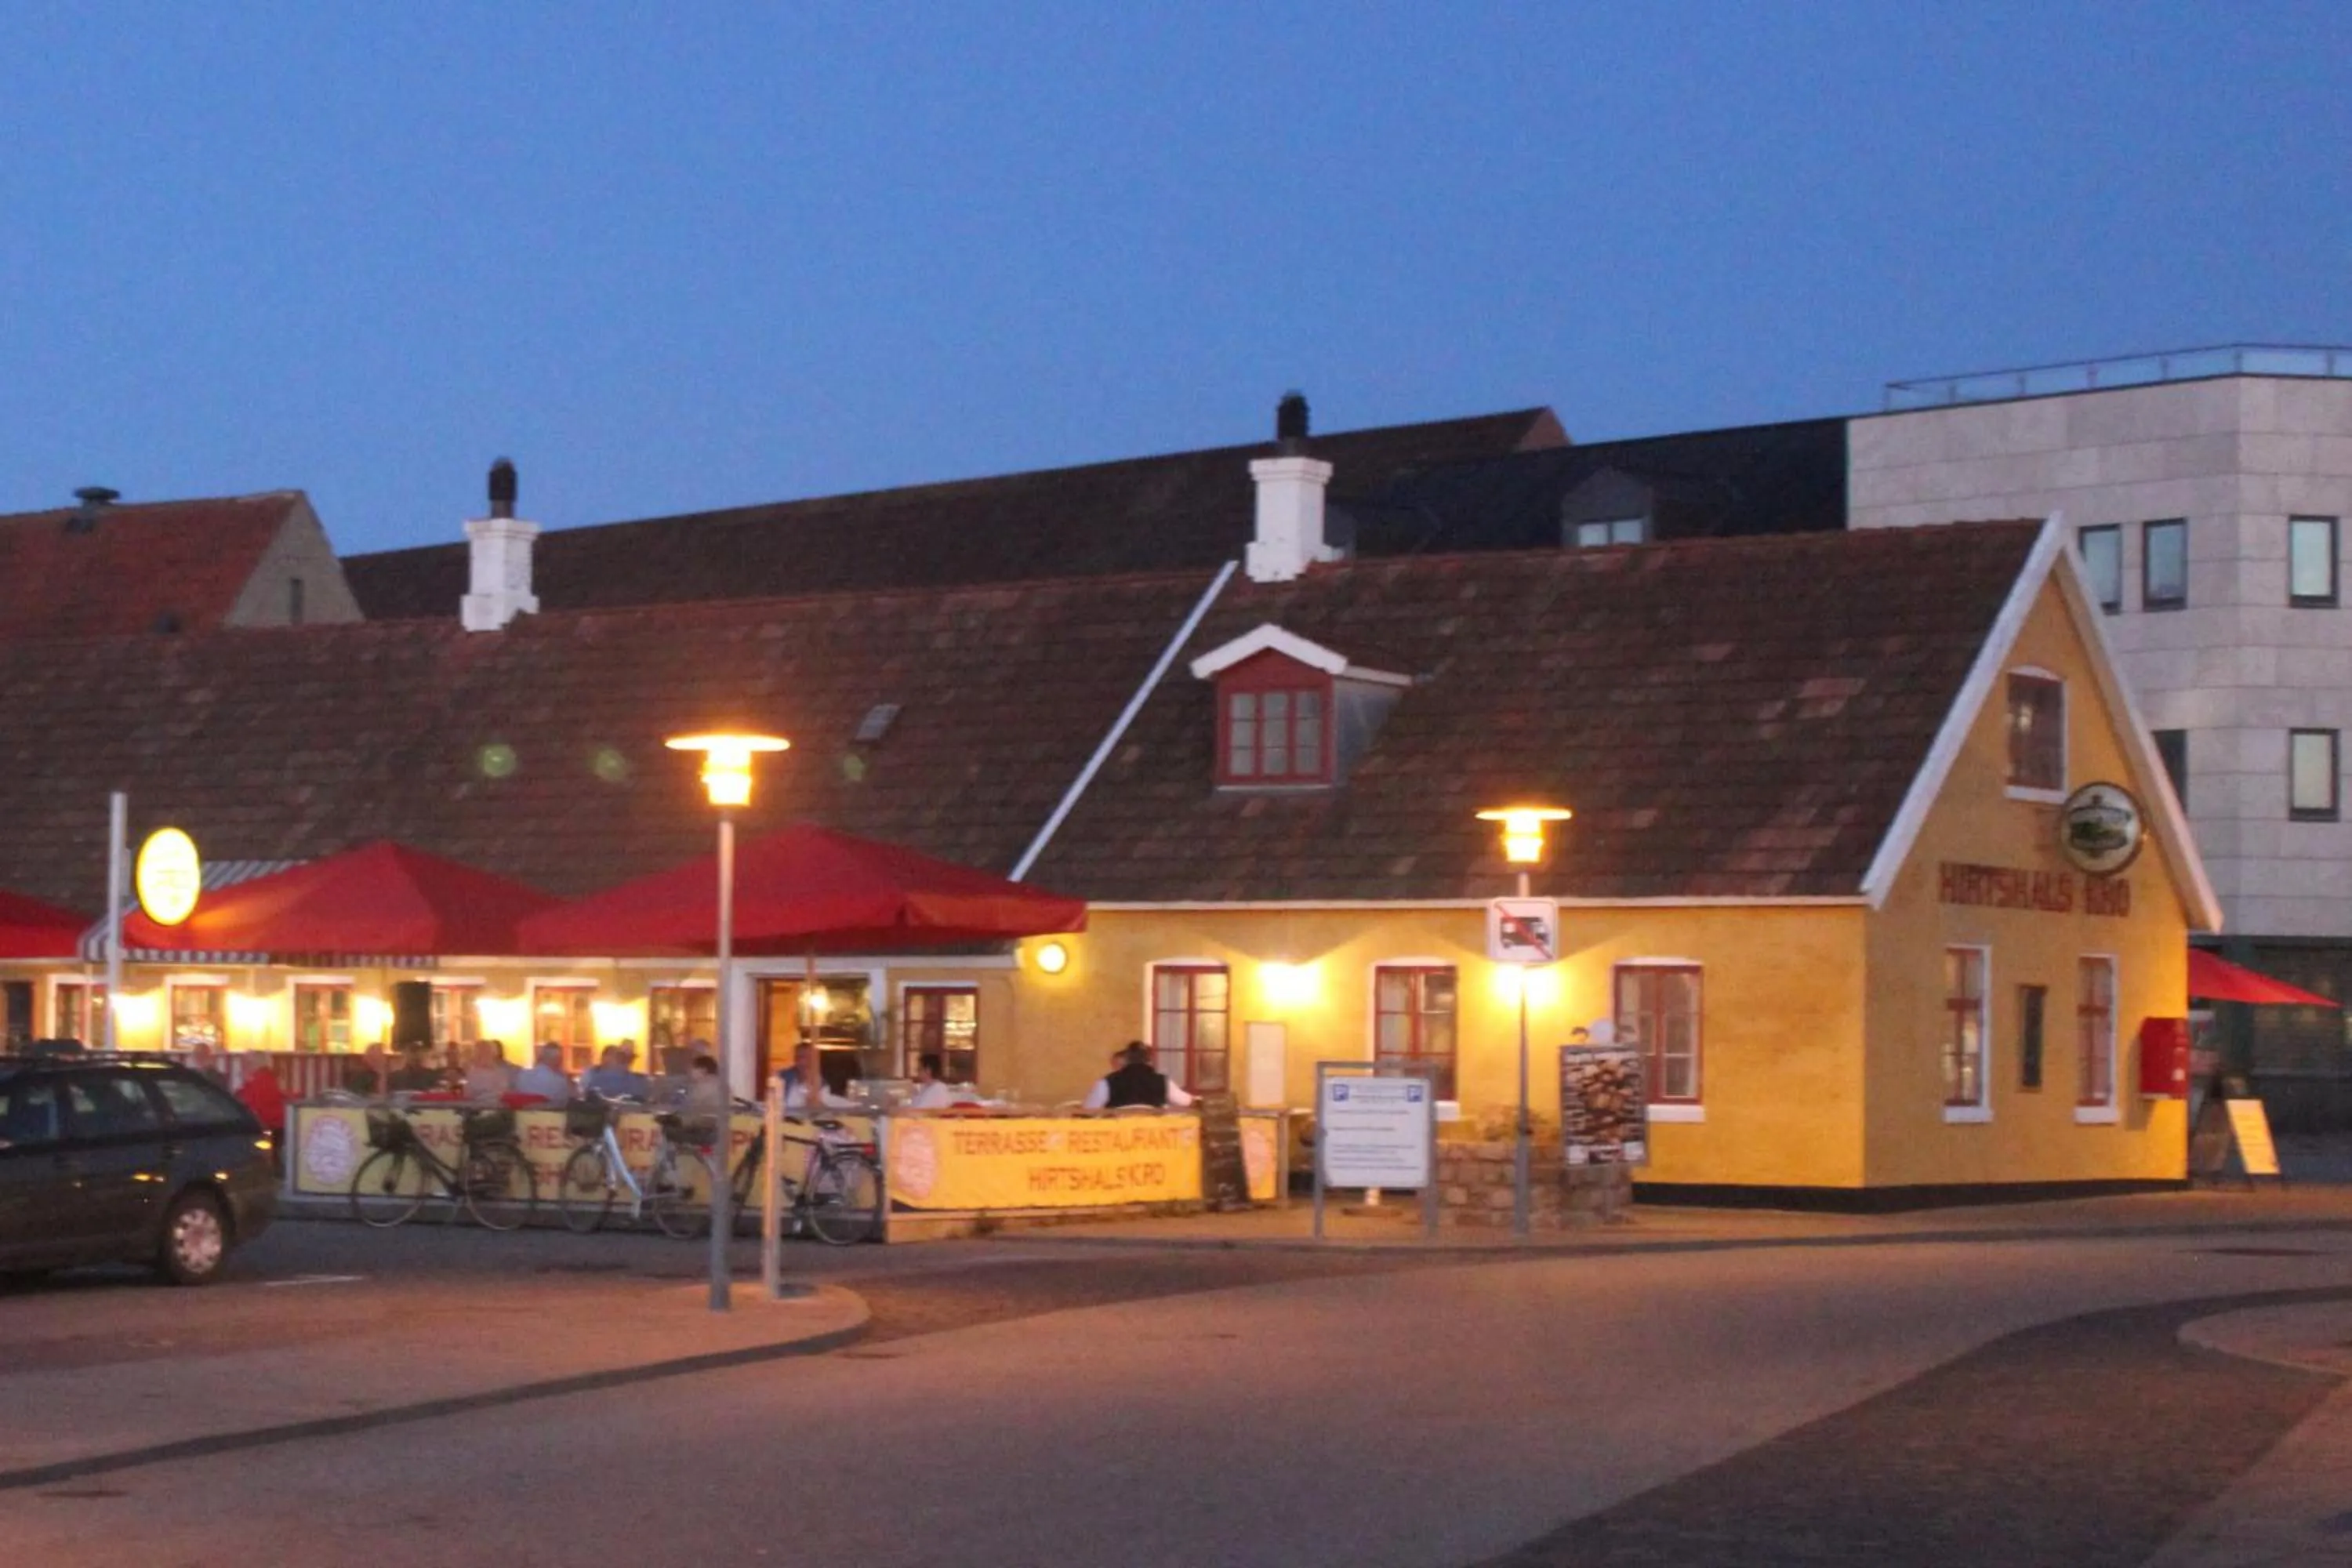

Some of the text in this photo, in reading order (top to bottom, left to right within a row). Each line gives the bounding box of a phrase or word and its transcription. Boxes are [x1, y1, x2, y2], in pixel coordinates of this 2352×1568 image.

[1940, 862, 2074, 913] HIRTSHALS
[952, 1127, 1182, 1156] TERRASSE RESTAURANT
